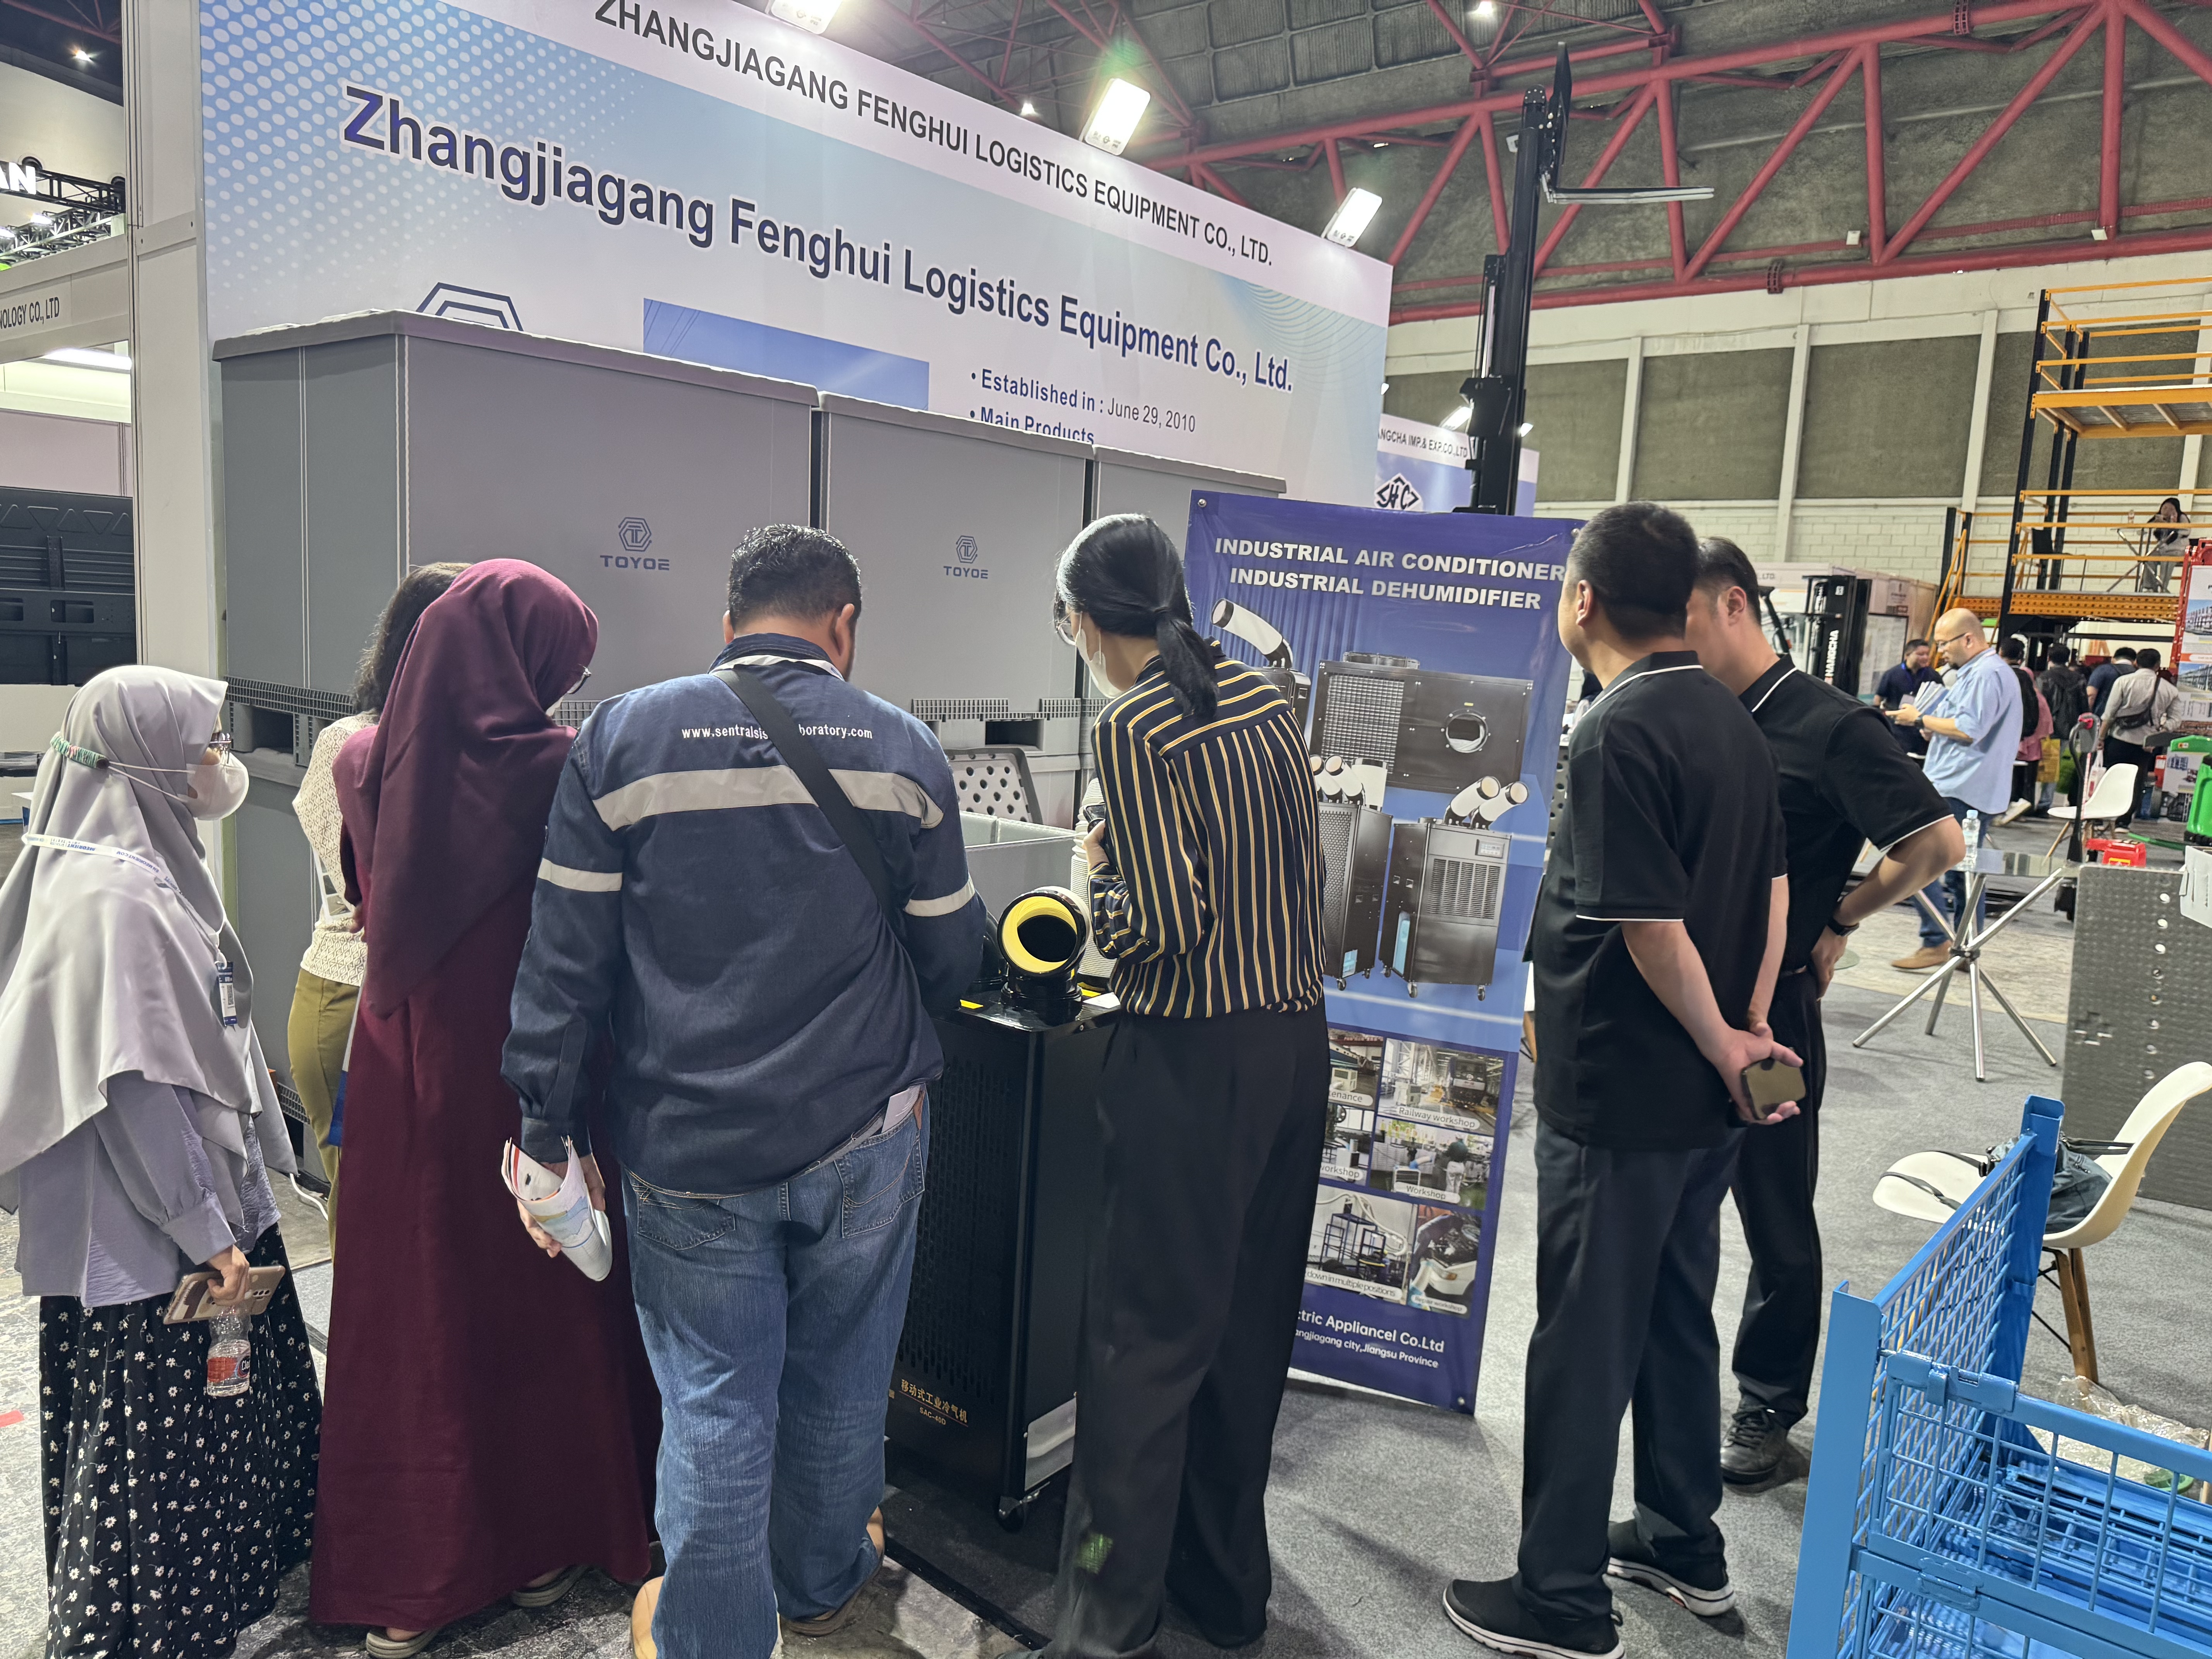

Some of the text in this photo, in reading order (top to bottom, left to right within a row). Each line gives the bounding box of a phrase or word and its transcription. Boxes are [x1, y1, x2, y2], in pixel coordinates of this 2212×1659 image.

[595, 0, 1272, 266] ZHANGJIAGANG FENGHUI LOGISTICS EQUIPMENT CO., LTD.
[344, 85, 1293, 391] Zhangjiagang Fenghui Logistics Equipment Co., Ltd.
[46, 297, 59, 319] LTD
[982, 368, 1077, 408] Established
[1082, 392, 1095, 411] in
[1108, 398, 1139, 421] June
[1143, 405, 1161, 428] 29,
[1165, 410, 1195, 432] 2010
[981, 407, 1019, 429] Main
[600, 555, 670, 571] TOYOE
[1215, 537, 1565, 581] INDUSTRIAL AIR CONDITIONER
[943, 566, 988, 579] TOYOE
[1230, 567, 1541, 610] INDUSTRIAL DEHUMIDIFIER
[1329, 1091, 1363, 1102] enance
[1399, 1107, 1475, 1128] Railway workshop
[1407, 1185, 1446, 1200] Workshop
[1325, 1315, 1397, 1342] Appliancel
[1400, 1332, 1445, 1353] Co.Ltd
[1399, 1351, 1439, 1369] Province
[901, 1379, 967, 1423] 移动式工业冷气机
